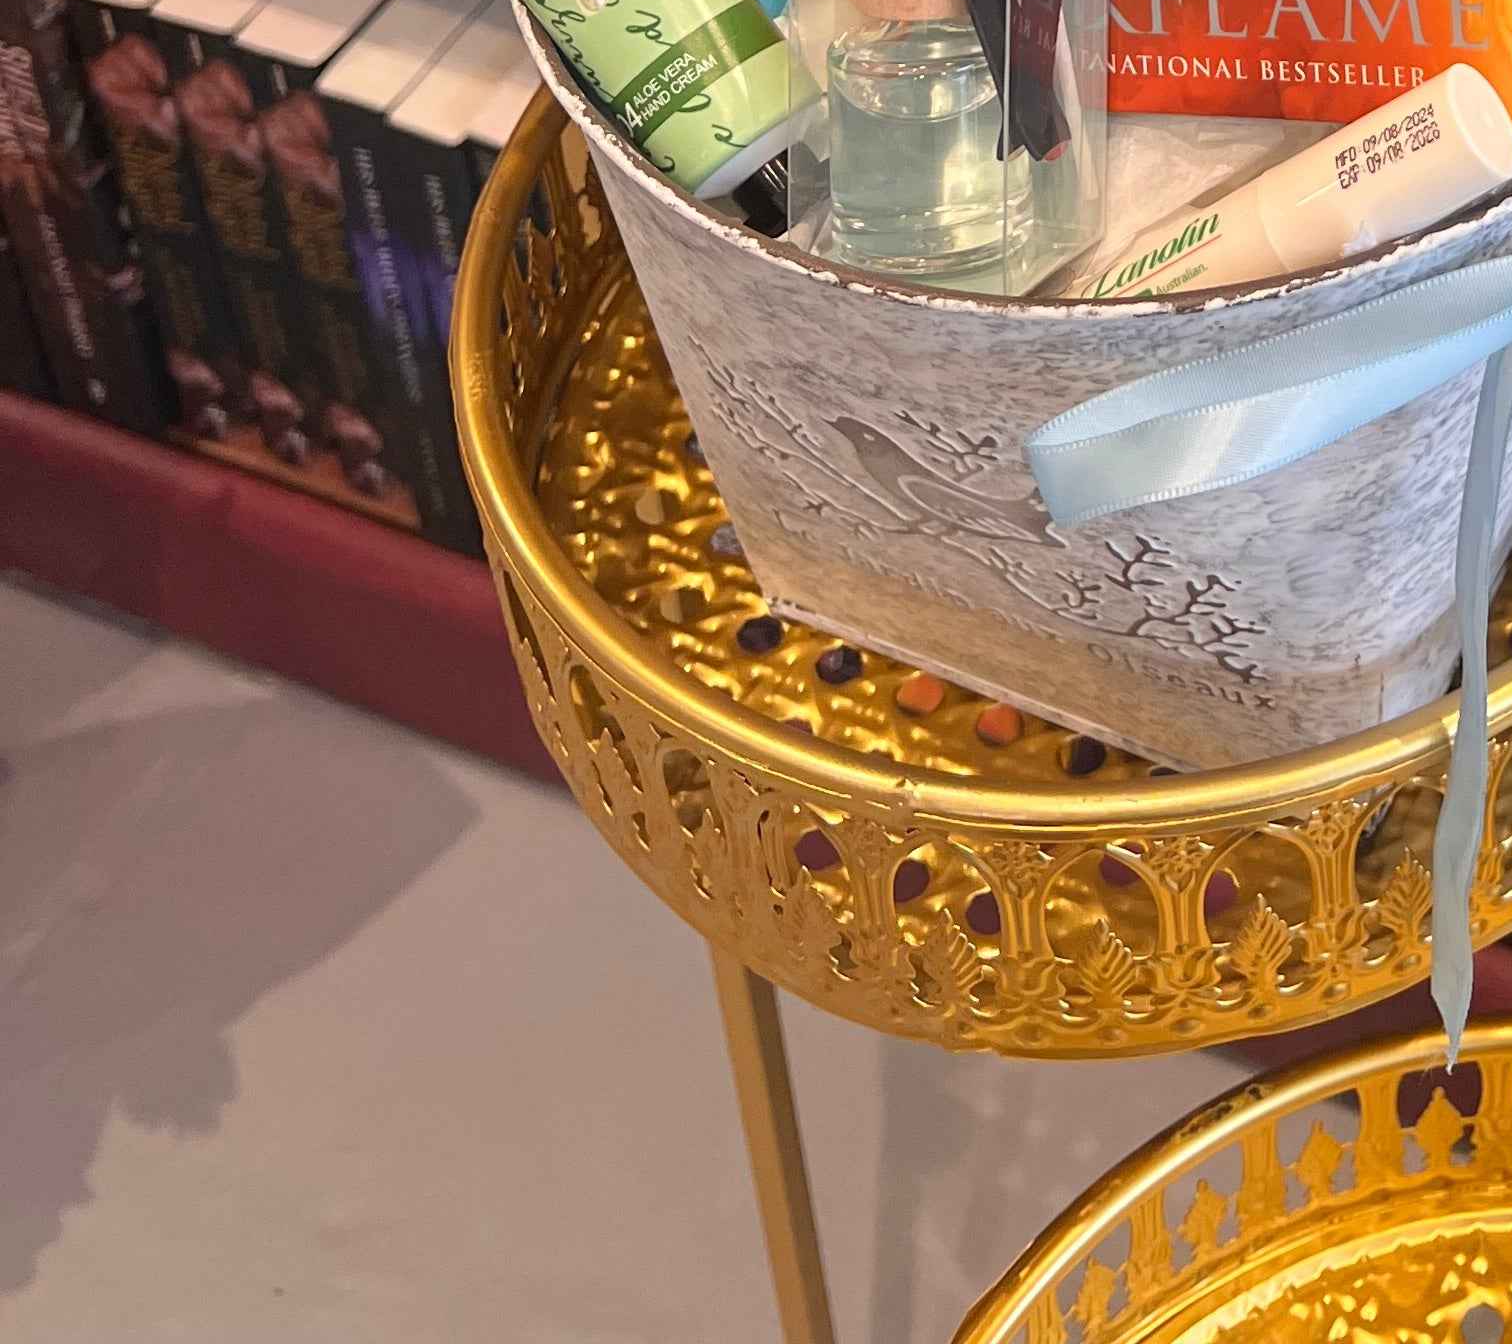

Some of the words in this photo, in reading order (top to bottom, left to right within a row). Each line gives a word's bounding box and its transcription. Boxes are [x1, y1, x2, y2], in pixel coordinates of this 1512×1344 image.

[632, 77, 662, 109] ALOE
[657, 52, 696, 83] VERA
[640, 89, 672, 121] HAND
[670, 53, 719, 95] CREAM
[1260, 60, 1426, 89] BESTSELLER
